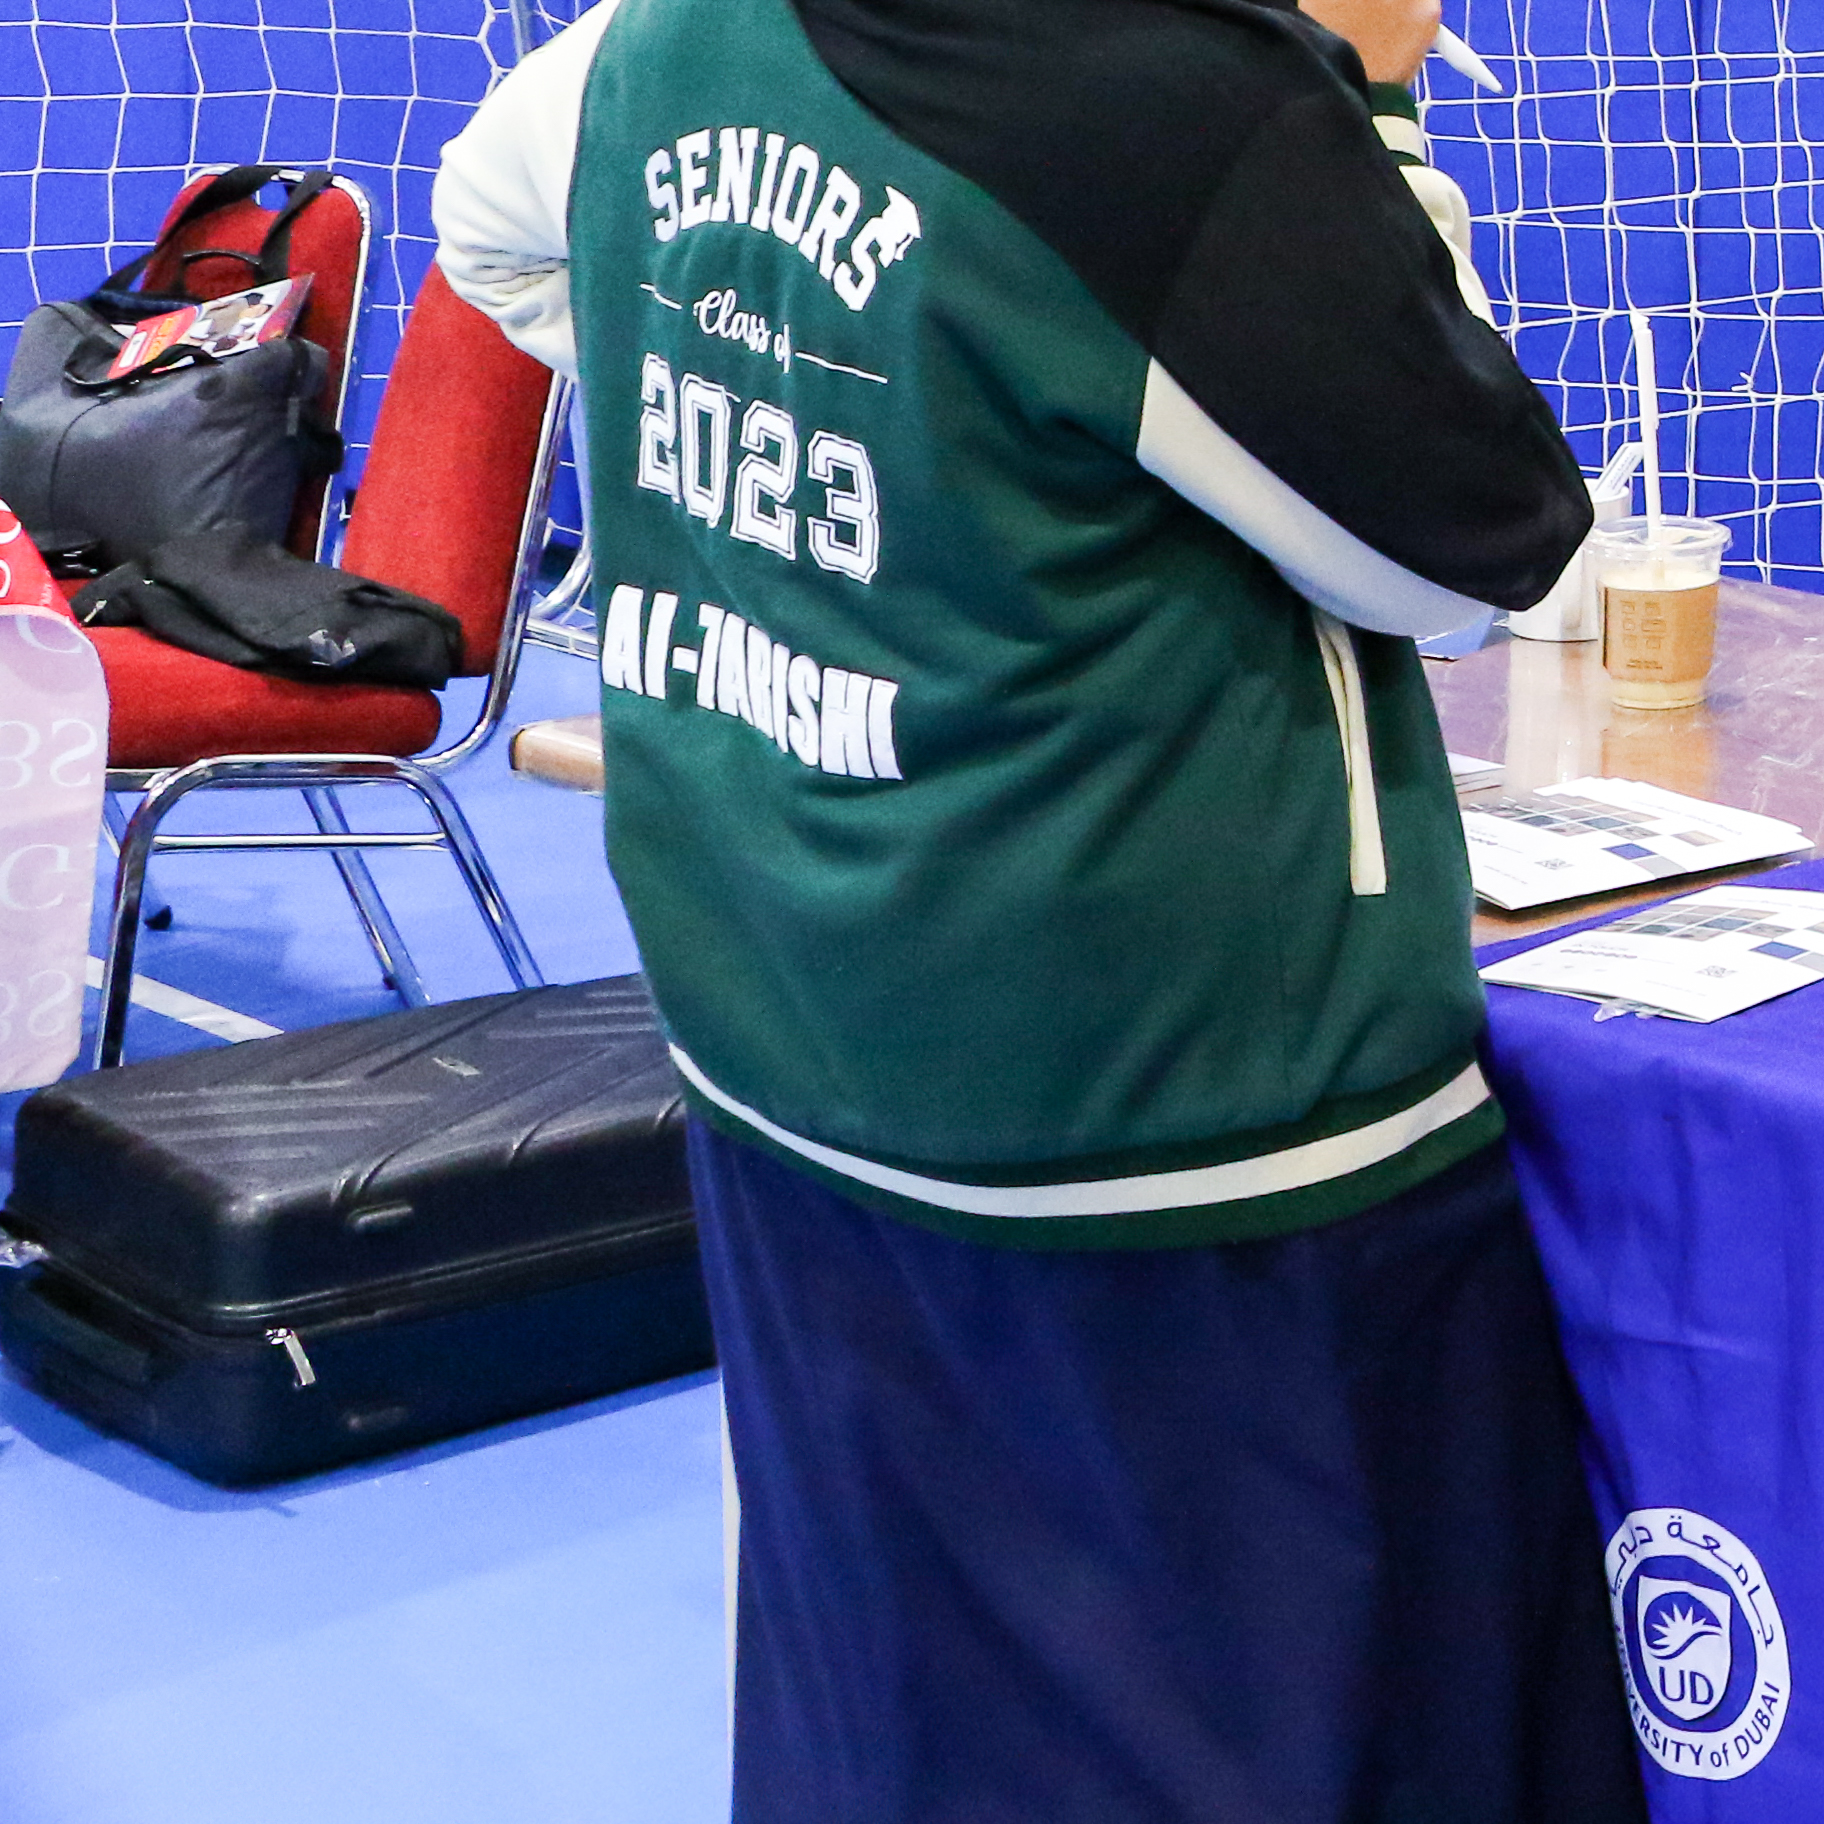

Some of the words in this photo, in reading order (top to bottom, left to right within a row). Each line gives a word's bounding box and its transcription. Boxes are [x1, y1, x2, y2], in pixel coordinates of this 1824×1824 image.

[645, 126, 900, 312] SENIORS
[693, 288, 771, 354] Class
[637, 352, 881, 585] 2023
[1667, 1515, 1774, 1649] جامعة
[1658, 1666, 1714, 1705] UD
[1710, 1743, 1729, 1768] of
[1733, 1681, 1780, 1759] DUBAI
